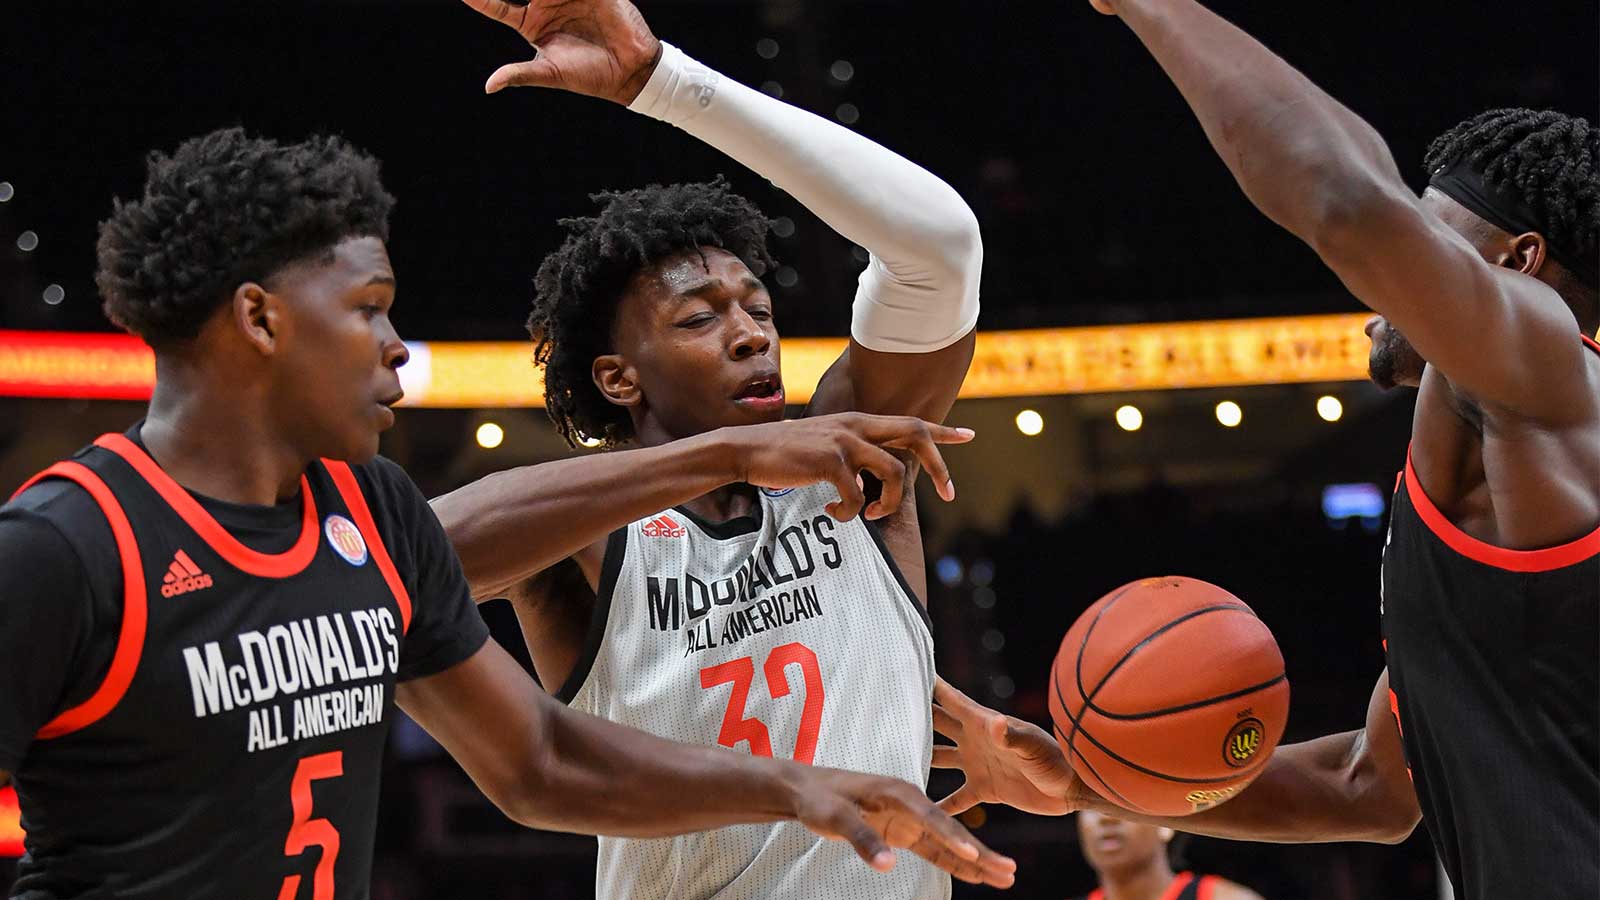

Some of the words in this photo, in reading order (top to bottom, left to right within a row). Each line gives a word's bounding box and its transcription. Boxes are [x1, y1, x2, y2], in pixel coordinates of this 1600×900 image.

[642, 526, 686, 538] adidas
[647, 514, 842, 631] MDONALD'S
[161, 573, 213, 598] adidas
[684, 618, 717, 657] ALL
[721, 585, 823, 646] AMERICAN
[182, 607, 399, 718] McDONALD'S
[700, 642, 825, 766] 32
[248, 705, 288, 752] ALL
[293, 683, 384, 740] AMERICAN
[277, 750, 344, 900] 5
